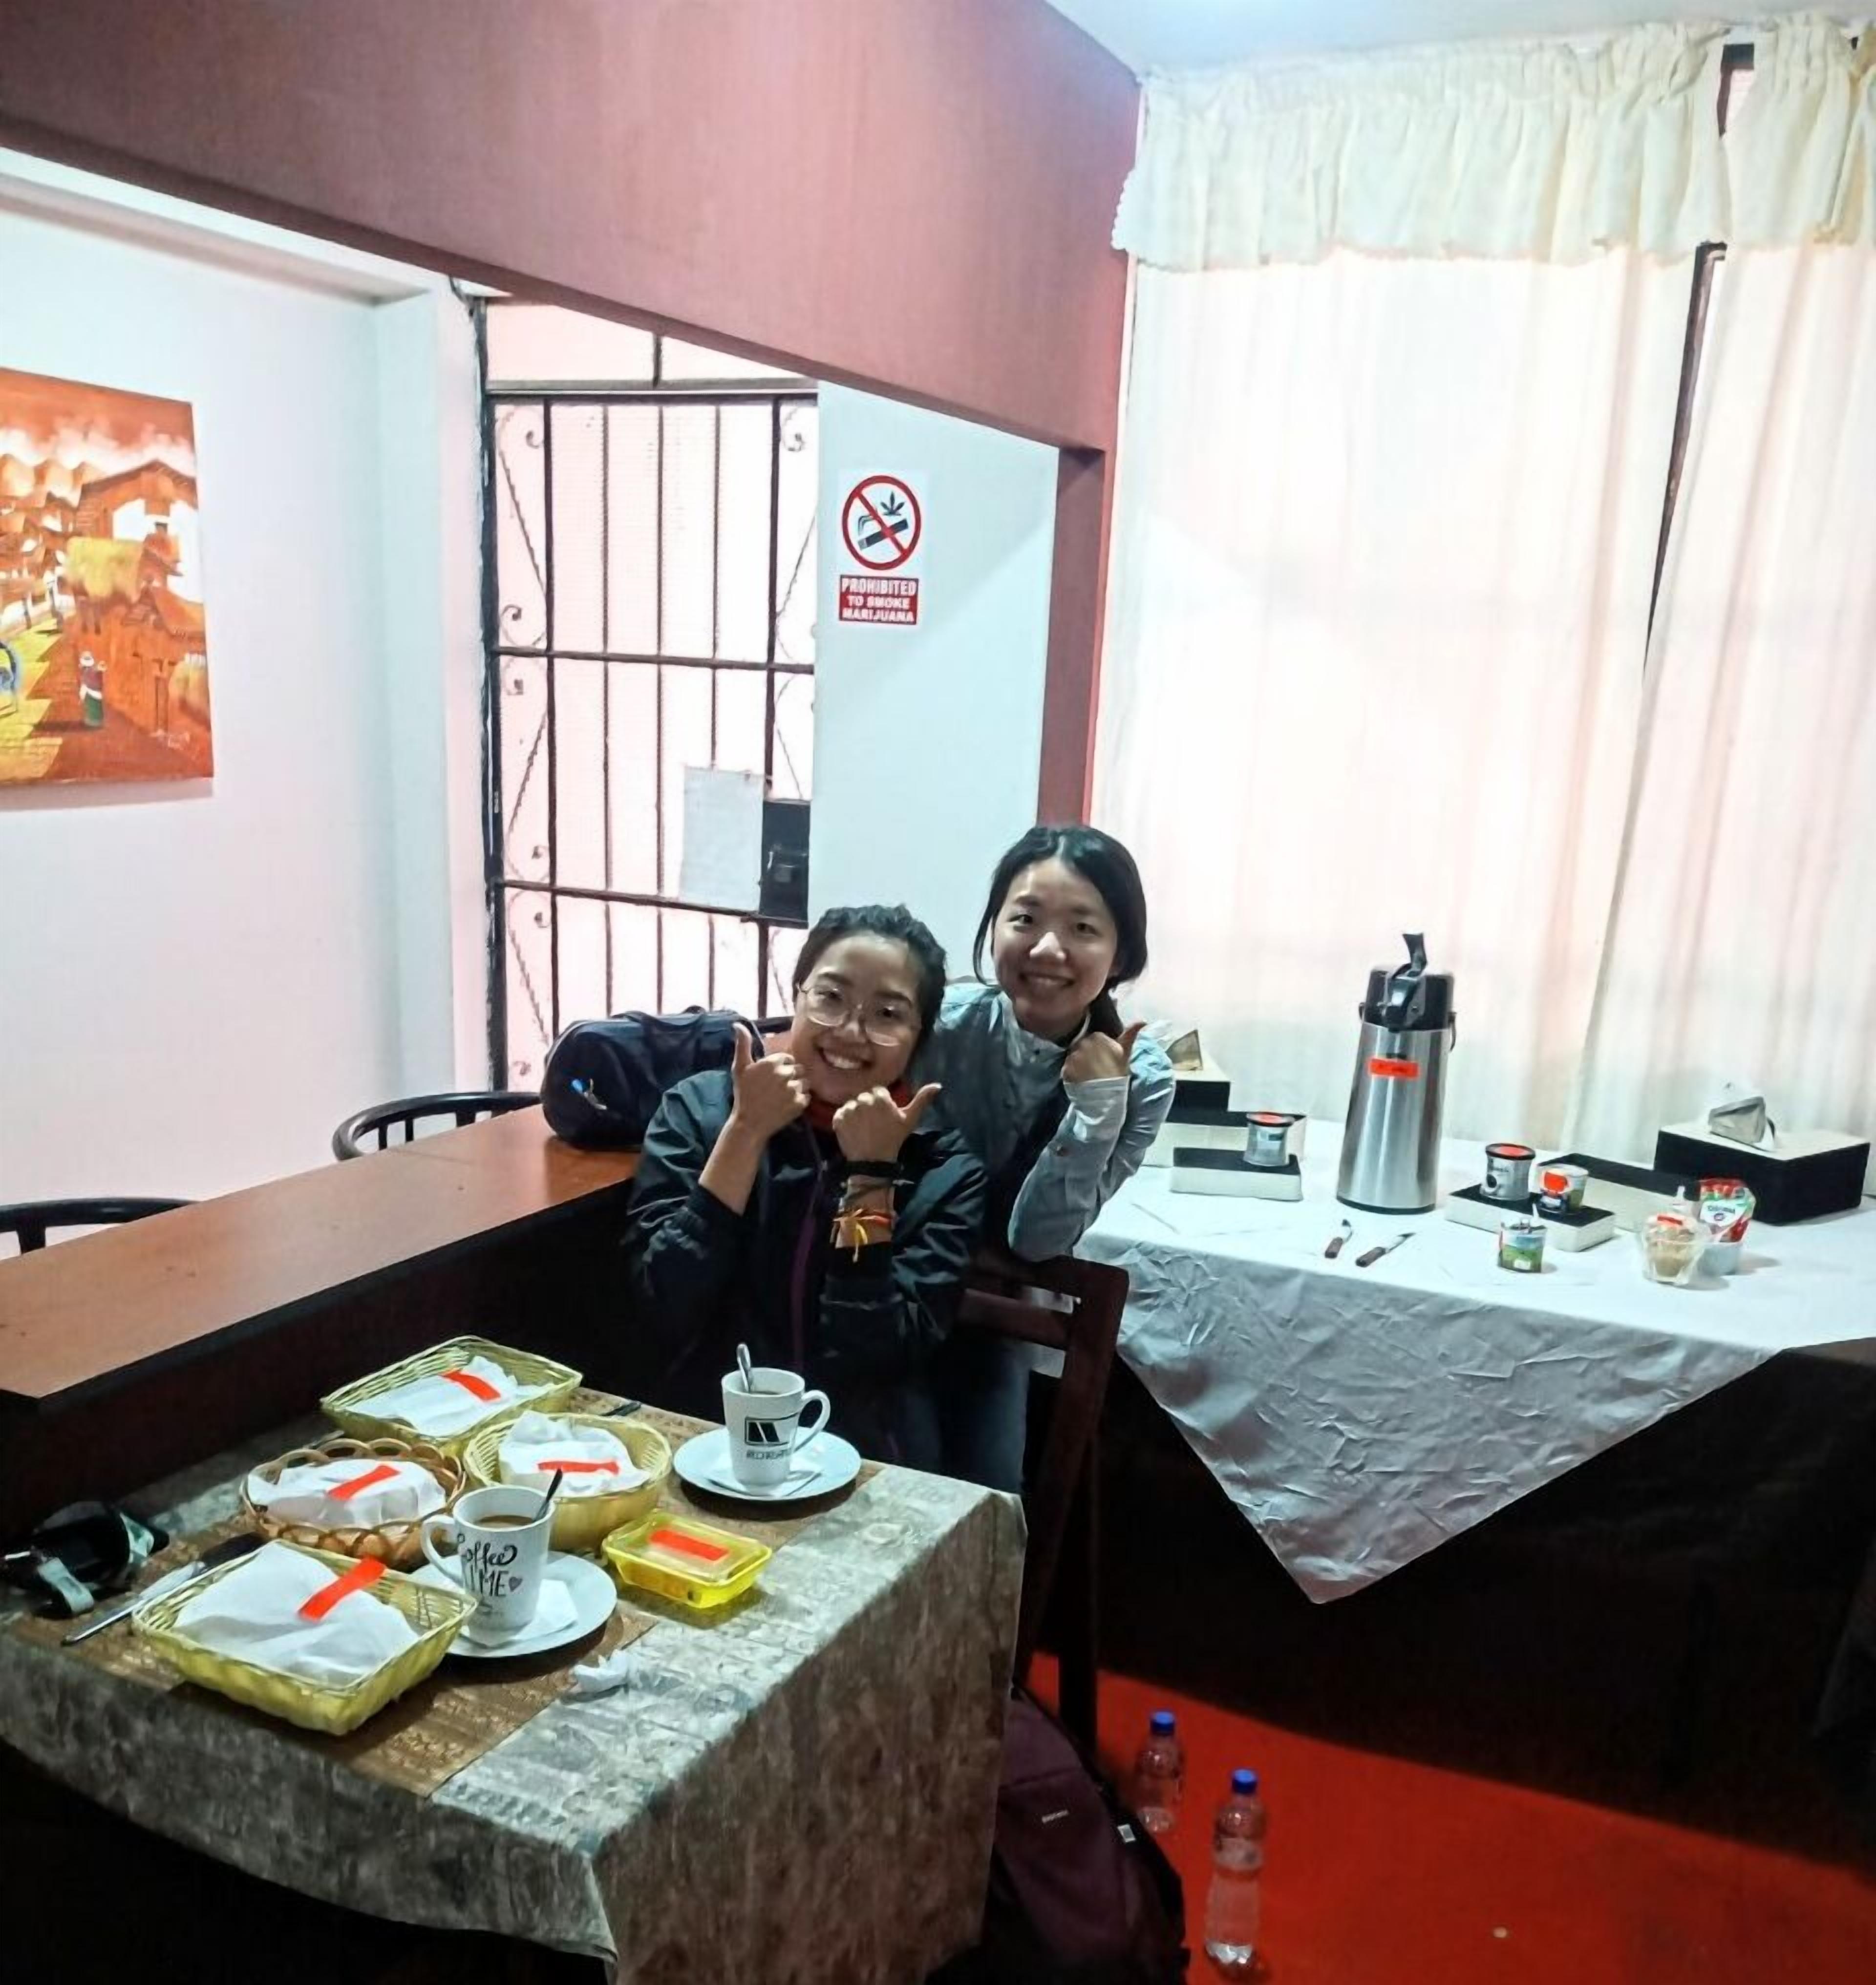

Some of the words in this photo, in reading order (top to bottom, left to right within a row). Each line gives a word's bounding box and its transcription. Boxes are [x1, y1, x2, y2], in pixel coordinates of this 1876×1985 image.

[842, 578, 917, 596] PROHIBITED
[847, 595, 864, 606] TO
[867, 596, 910, 610] SMOKE
[842, 607, 915, 622] MARIJUANA
[464, 1564, 509, 1597] IME
